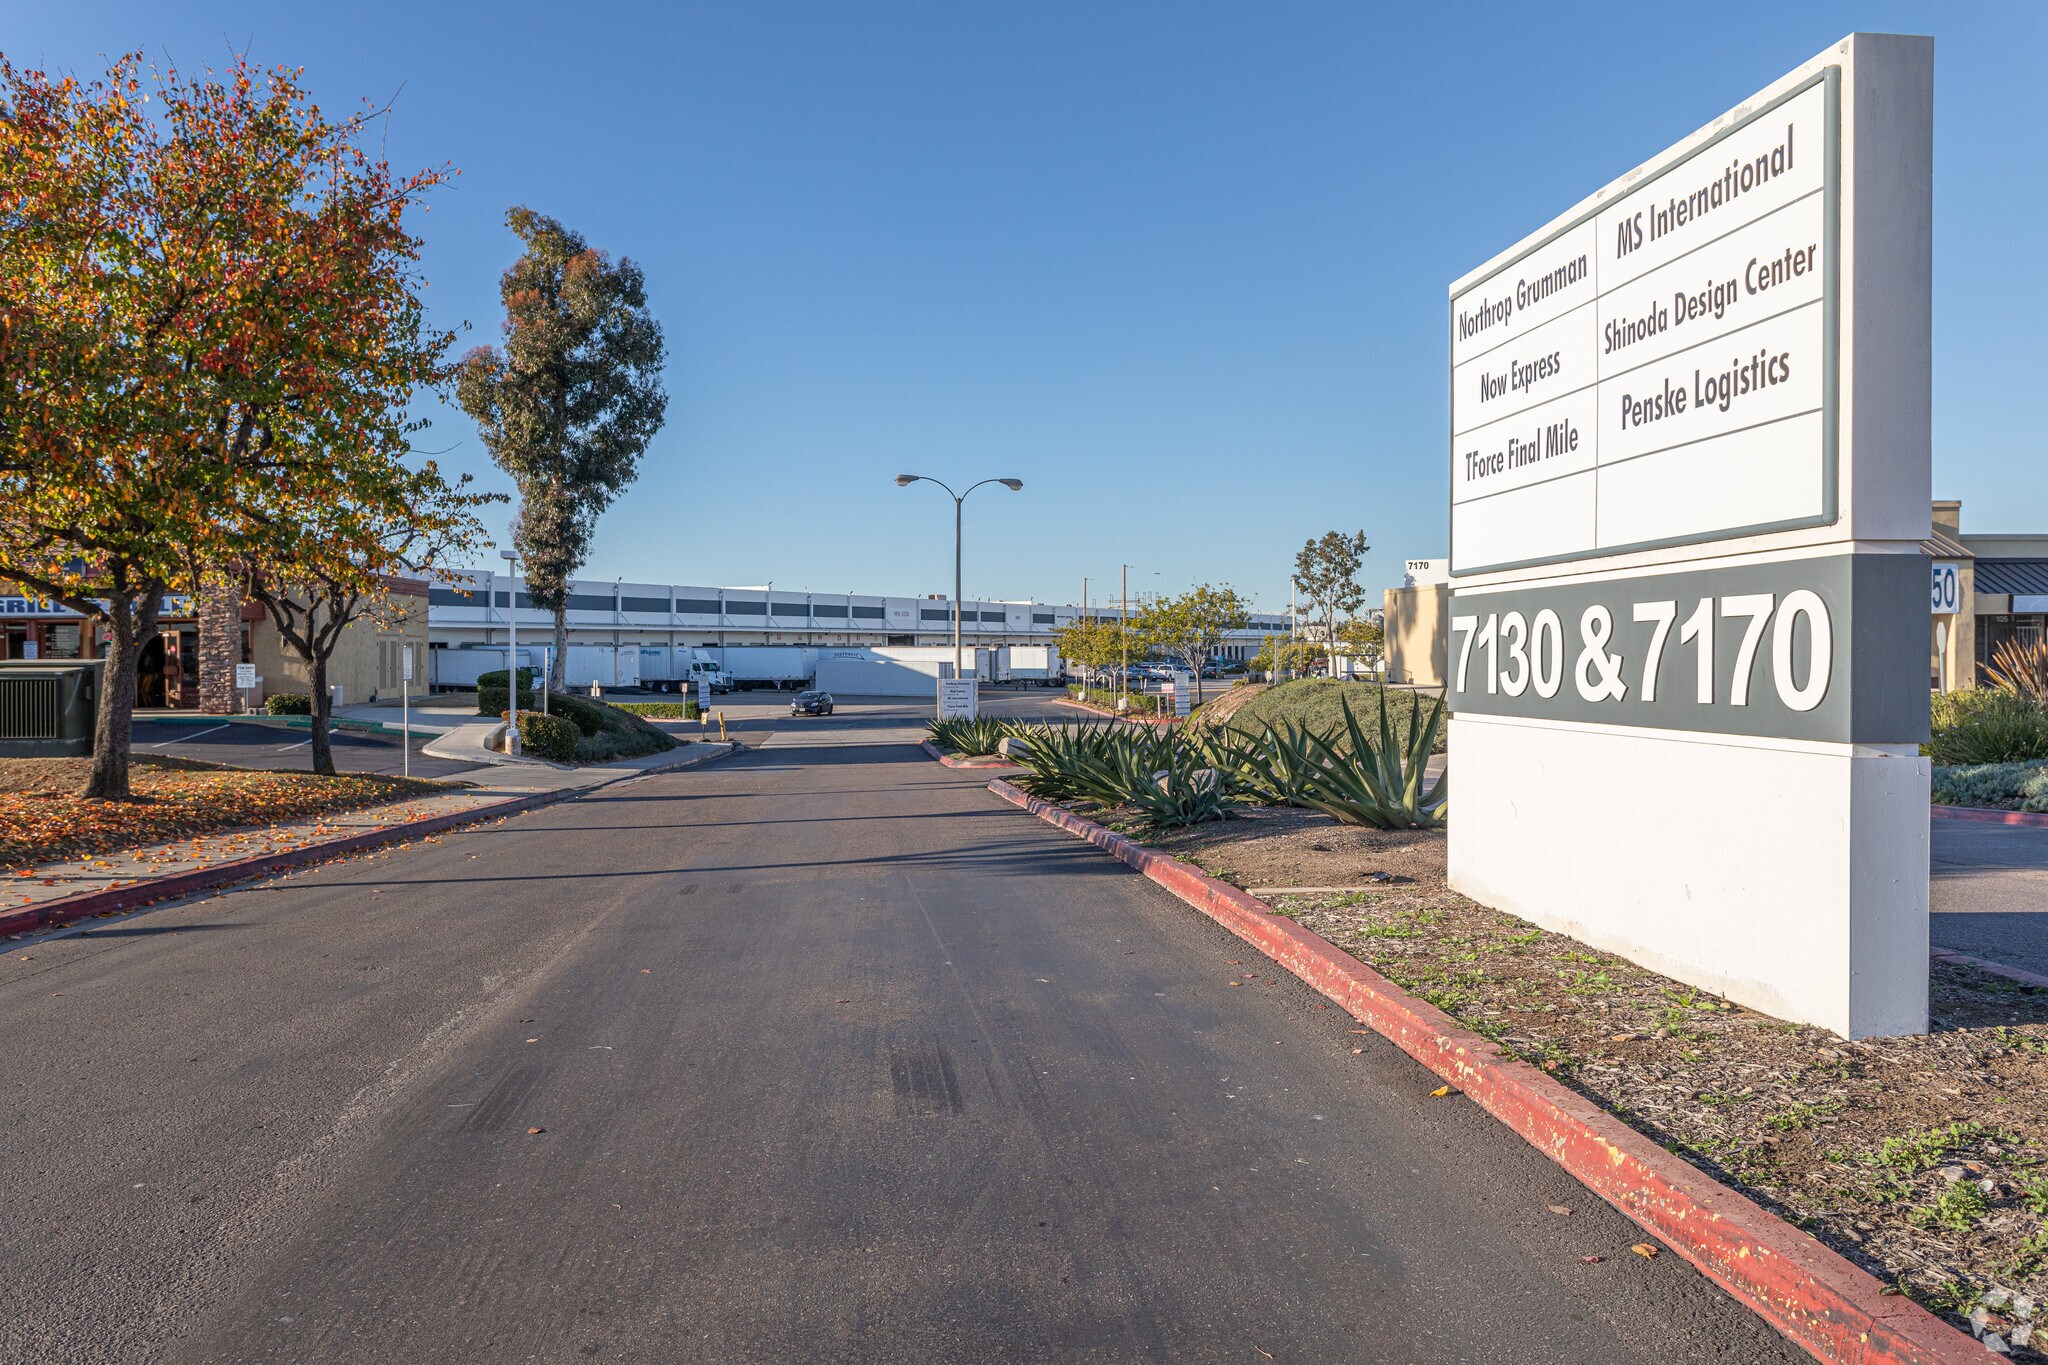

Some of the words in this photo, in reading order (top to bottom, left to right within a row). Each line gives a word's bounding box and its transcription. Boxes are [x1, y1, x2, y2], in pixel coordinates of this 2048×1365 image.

[1616, 211, 1643, 260] MS
[1650, 122, 1794, 242] International
[1459, 295, 1512, 342] Northrop
[1516, 254, 1587, 311] Grumman
[1604, 300, 1668, 355] Shinoda
[1674, 277, 1738, 327] Design
[1745, 243, 1817, 296] Center
[1481, 372, 1508, 404] Now
[1511, 351, 1561, 394] Express
[1622, 377, 1687, 431] Penske
[1694, 348, 1790, 413] Logistics
[1465, 450, 1504, 482] TForce
[1508, 427, 1541, 470] Final
[1545, 417, 1579, 459] Mile
[0, 599, 66, 613] RILL
[1408, 561, 1429, 570] 7170
[1452, 608, 1565, 699] 7130
[1575, 604, 1629, 703] &
[1633, 589, 1834, 712] 7170
